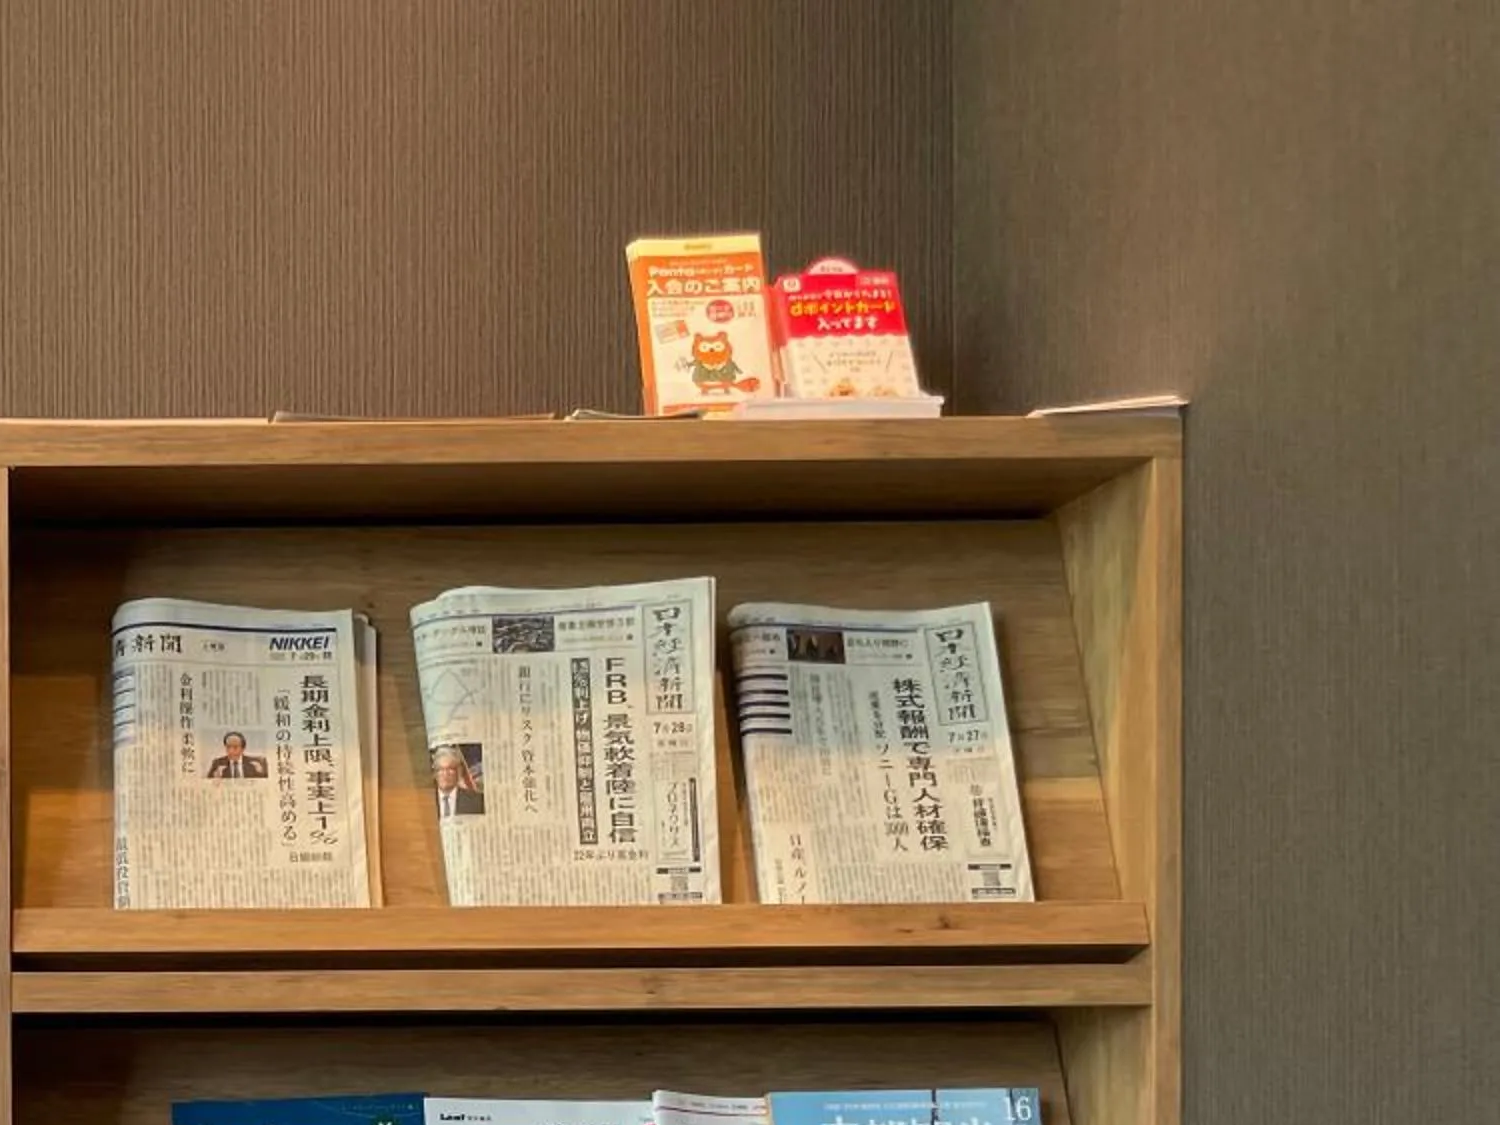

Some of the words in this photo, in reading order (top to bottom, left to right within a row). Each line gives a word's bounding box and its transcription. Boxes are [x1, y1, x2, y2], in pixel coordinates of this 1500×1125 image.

[647, 276, 761, 296] 入会のご案内
[790, 299, 896, 317] dポイントカード
[269, 636, 330, 652] NIKKEI
[1004, 1095, 1032, 1121] 16
